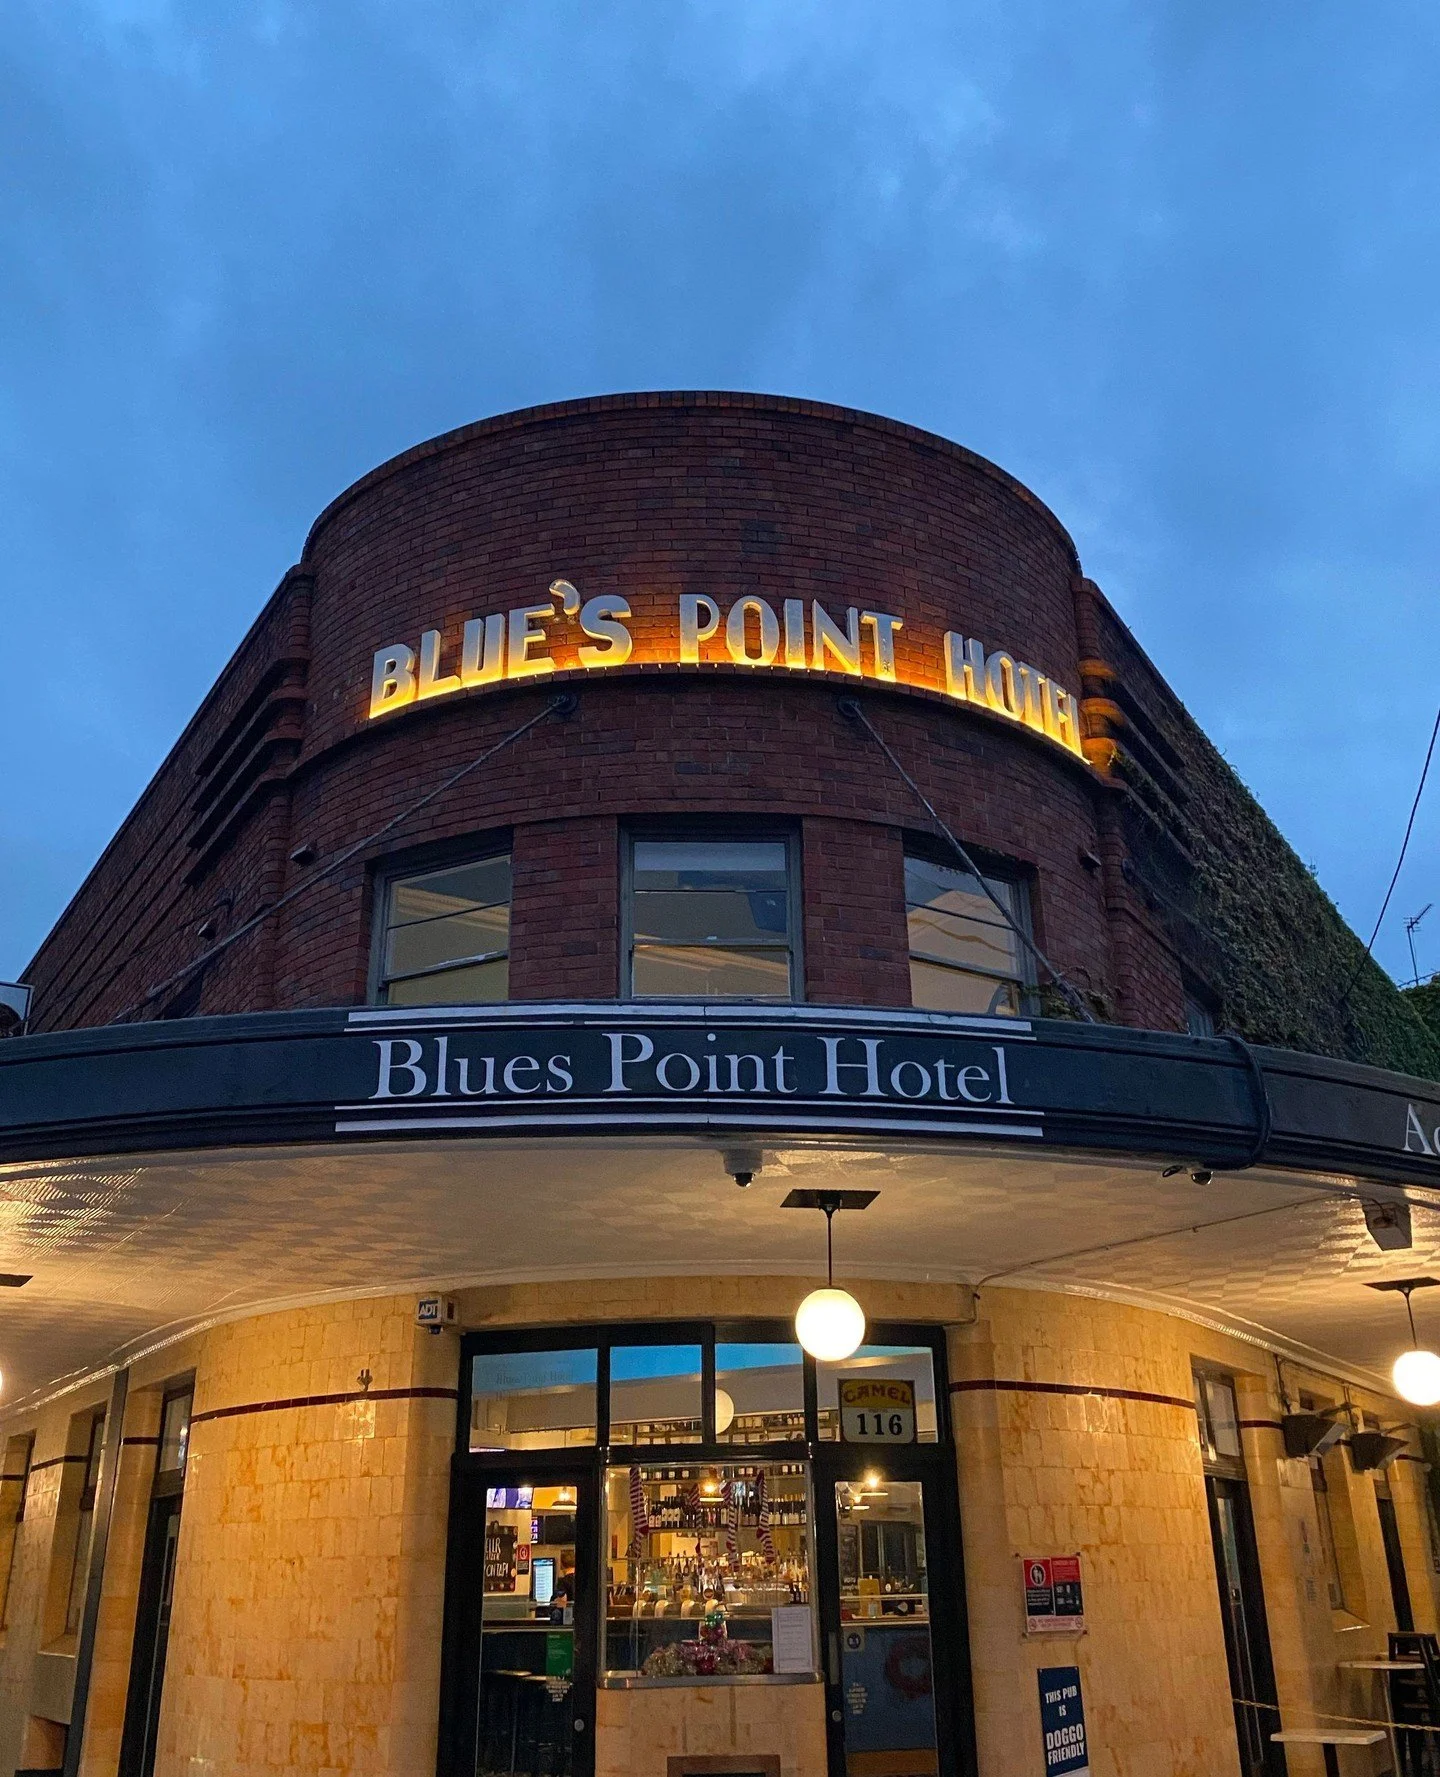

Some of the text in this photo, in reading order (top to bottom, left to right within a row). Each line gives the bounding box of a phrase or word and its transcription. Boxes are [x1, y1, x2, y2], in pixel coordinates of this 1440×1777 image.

[679, 593, 904, 683] POINT
[368, 1032, 1015, 1104] Blues Point Hotel
[419, 1303, 438, 1316] ADT
[843, 1384, 911, 1405] CAMEL
[857, 1413, 903, 1436] 116
[1045, 1685, 1077, 1704] THIS PUB
[1058, 1704, 1067, 1717] IS
[1046, 1723, 1084, 1750] DOGGO
[1047, 1741, 1085, 1766] FRIENDLY
